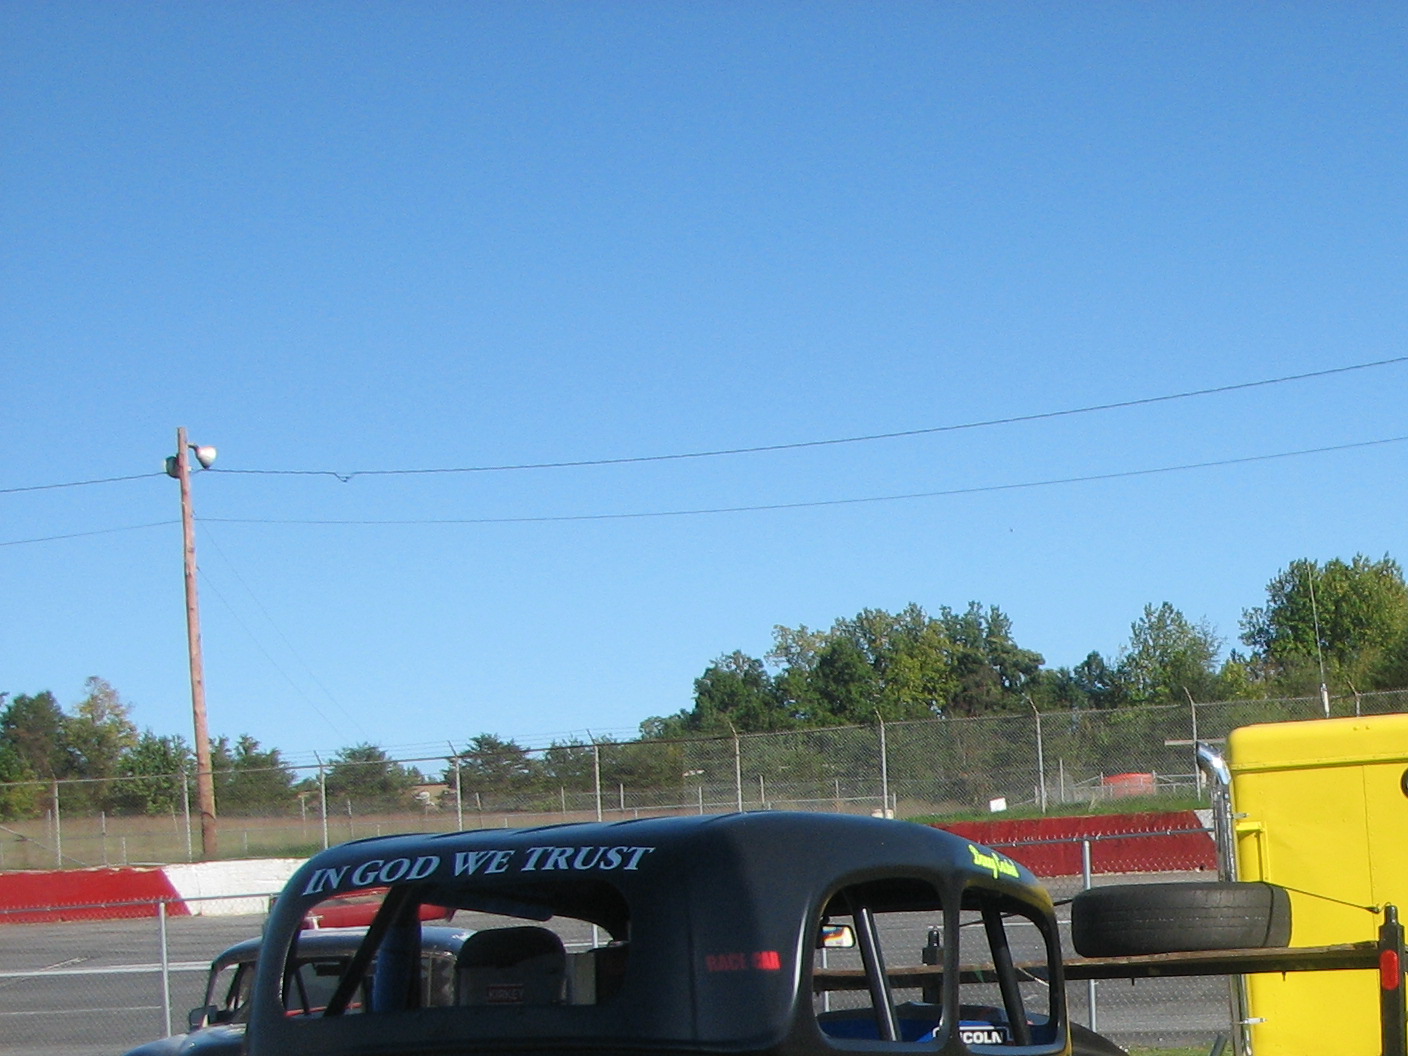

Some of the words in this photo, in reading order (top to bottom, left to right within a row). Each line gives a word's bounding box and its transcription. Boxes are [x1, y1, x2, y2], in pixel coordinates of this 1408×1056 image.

[303, 865, 350, 897] IN
[352, 854, 440, 886] GOD
[453, 849, 514, 877] WE
[520, 846, 655, 872] TRUST
